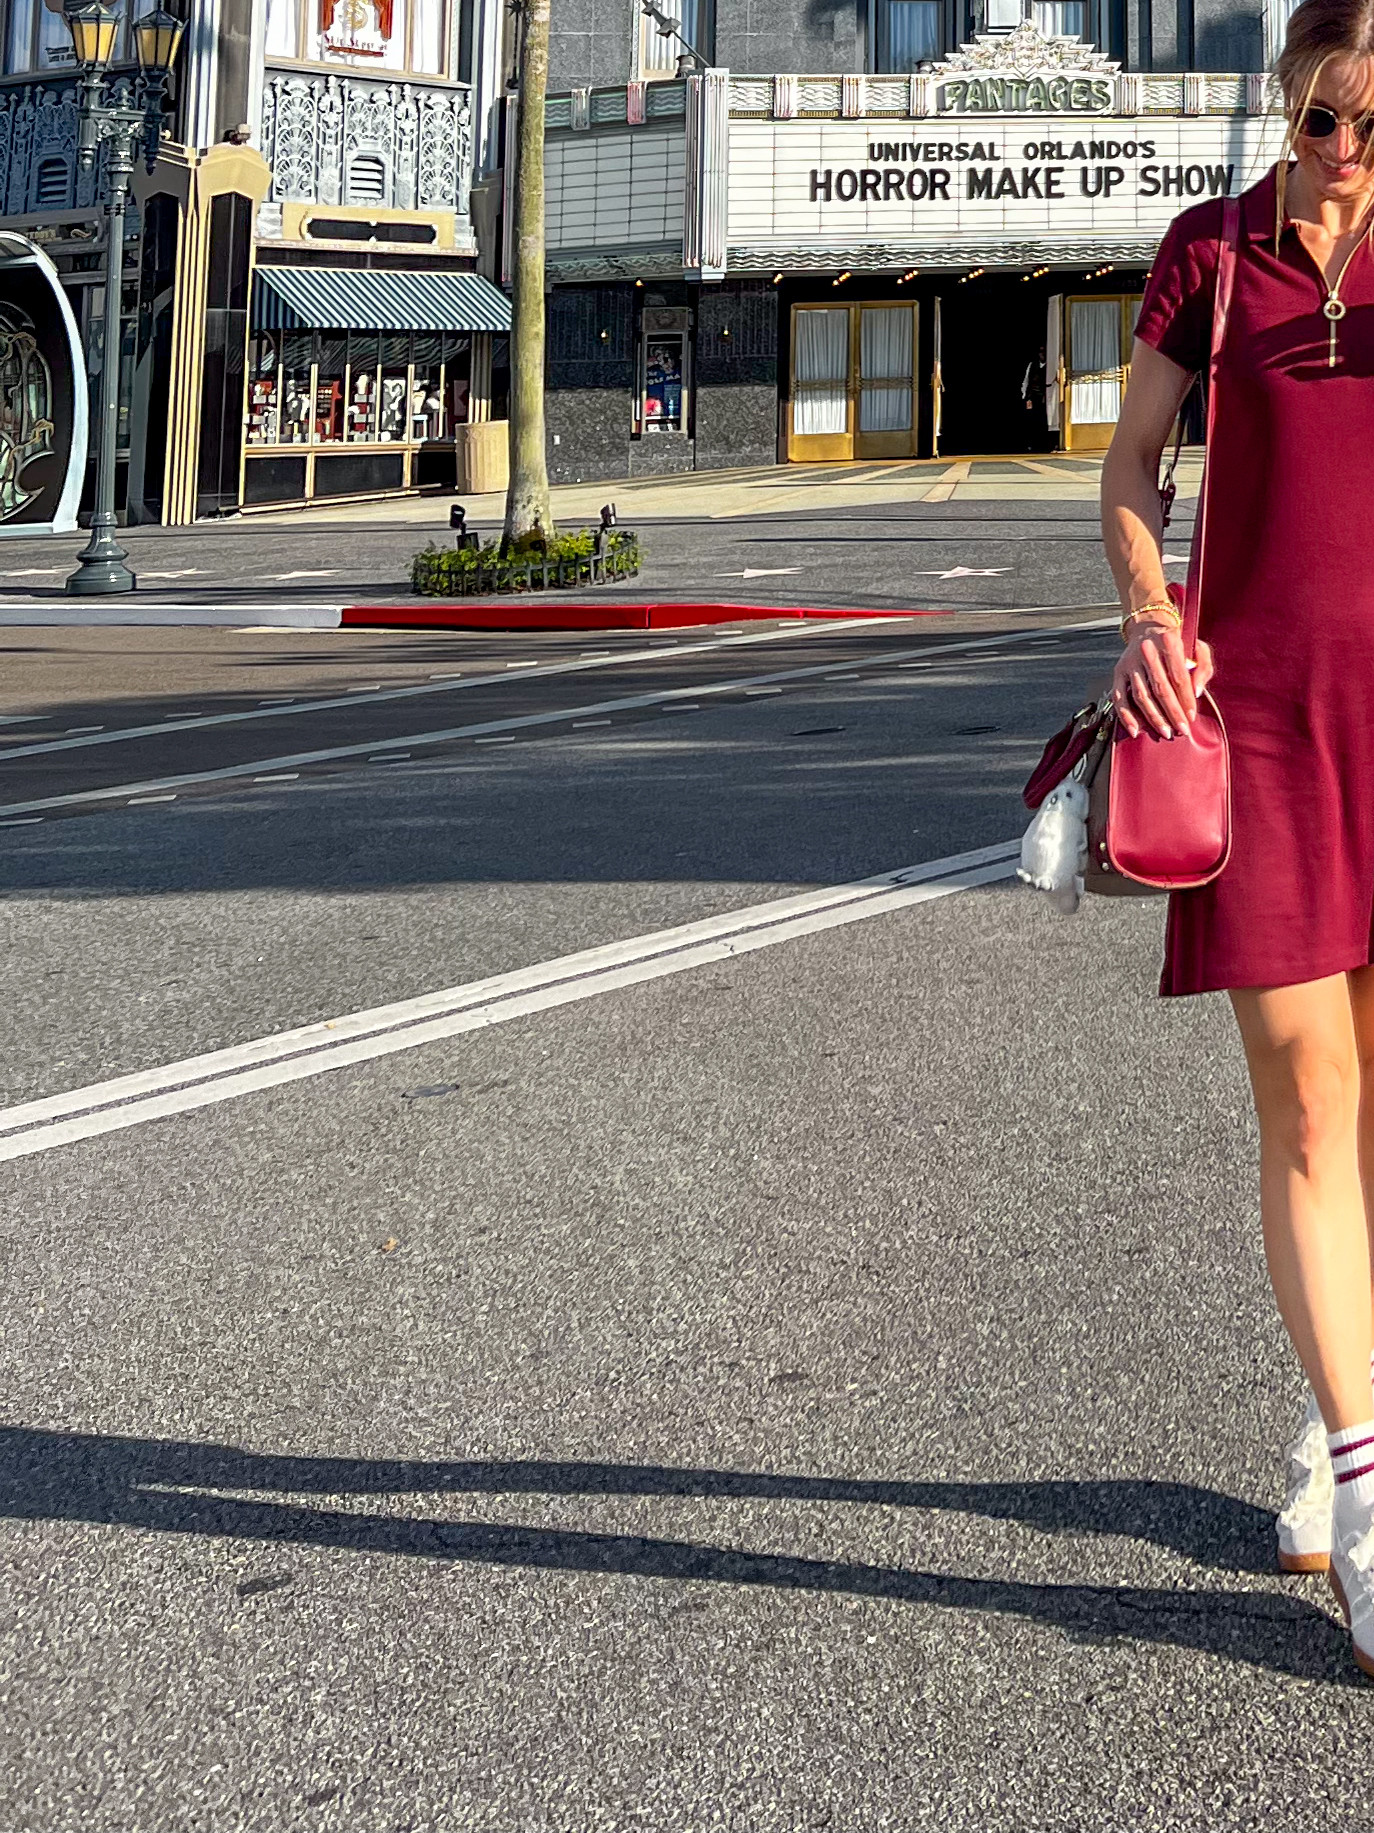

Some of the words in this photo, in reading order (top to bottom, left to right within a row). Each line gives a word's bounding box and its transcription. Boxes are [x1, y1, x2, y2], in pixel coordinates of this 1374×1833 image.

[938, 76, 1112, 112] PANTAGES
[868, 141, 1001, 162] UNIVERSAL
[1022, 140, 1157, 161] ORLANDO'S
[808, 168, 951, 202] HORROR
[966, 166, 1065, 200] MAKE
[1080, 166, 1125, 198] UP
[1138, 164, 1235, 197] SHOW
